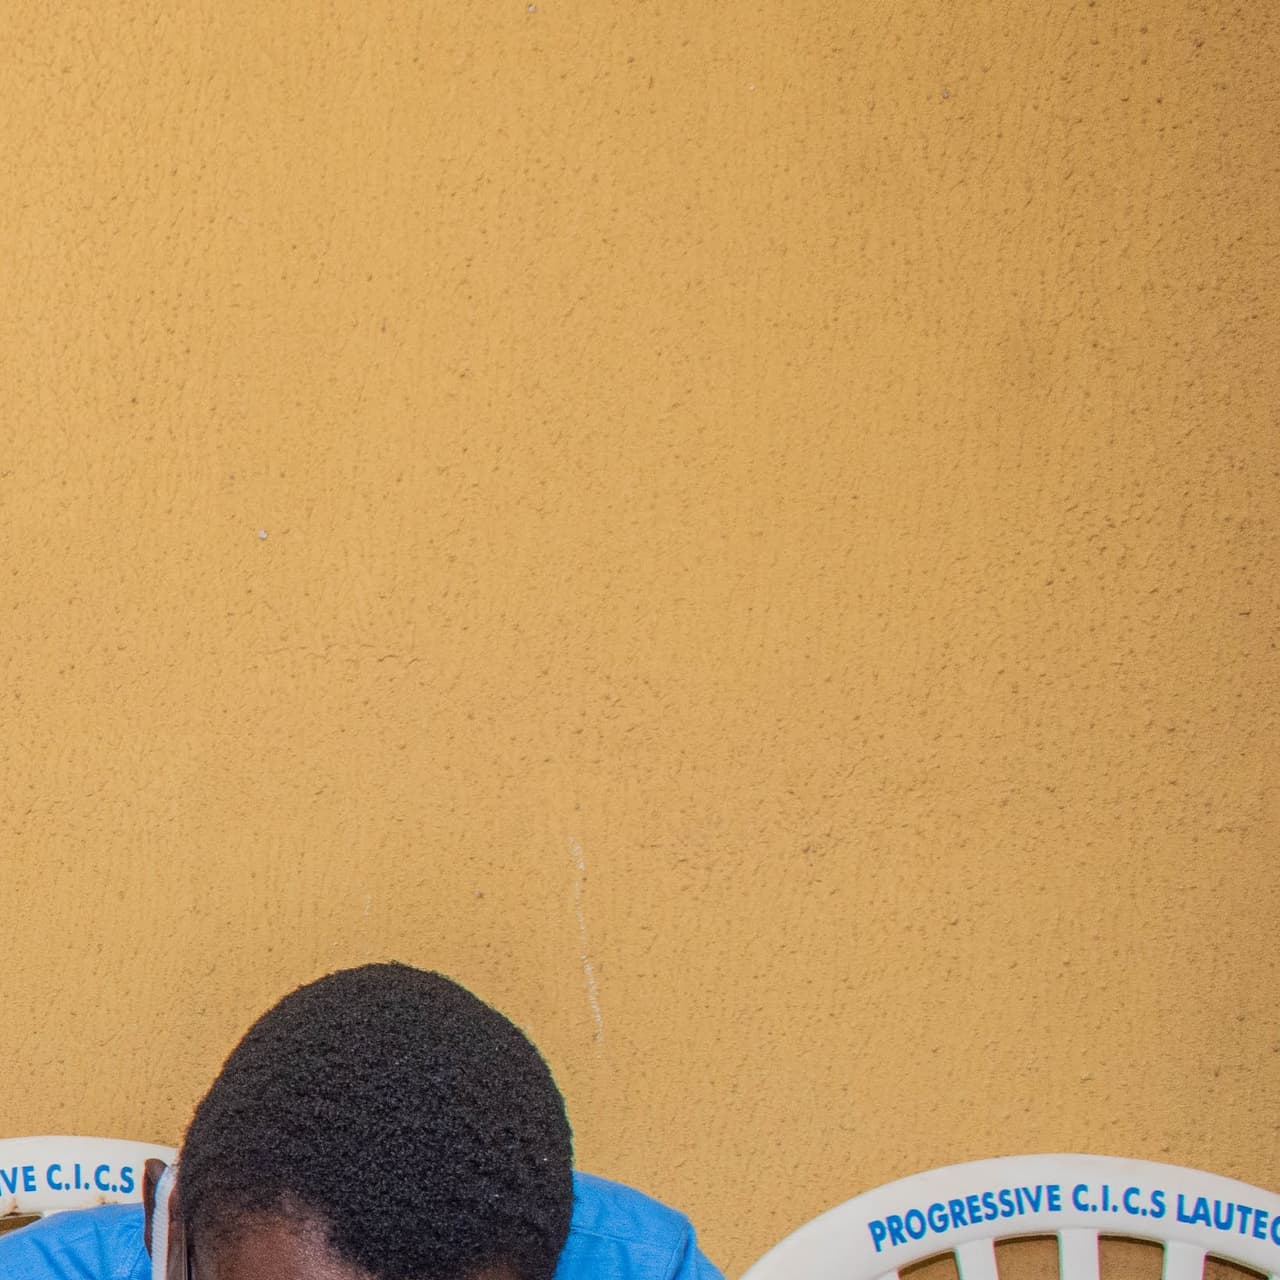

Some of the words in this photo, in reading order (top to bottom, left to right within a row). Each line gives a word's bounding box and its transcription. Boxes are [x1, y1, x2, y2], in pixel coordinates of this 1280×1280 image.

[46, 1163, 135, 1194] C.I.C.S
[867, 1183, 1062, 1253] PROGRESSIVE
[1071, 1183, 1166, 1219] C.I.C.S
